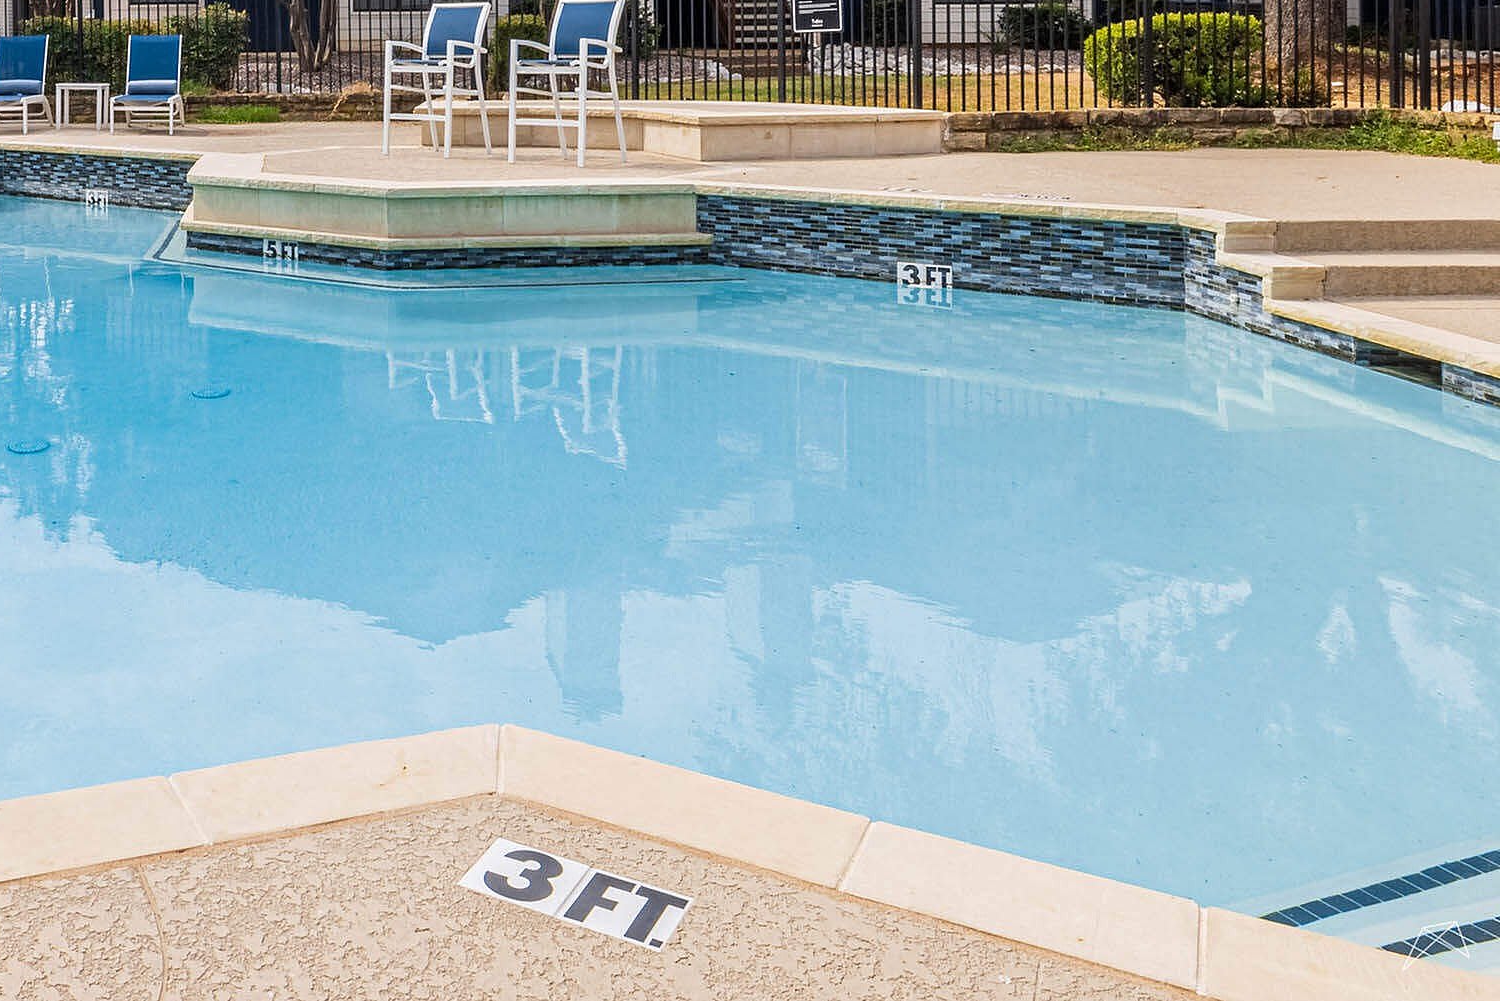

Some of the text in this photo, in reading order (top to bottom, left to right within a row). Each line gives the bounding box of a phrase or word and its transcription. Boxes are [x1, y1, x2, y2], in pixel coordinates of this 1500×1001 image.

[266, 240, 277, 258] 5
[901, 264, 921, 285] 3
[483, 850, 690, 948] 3 FT.
